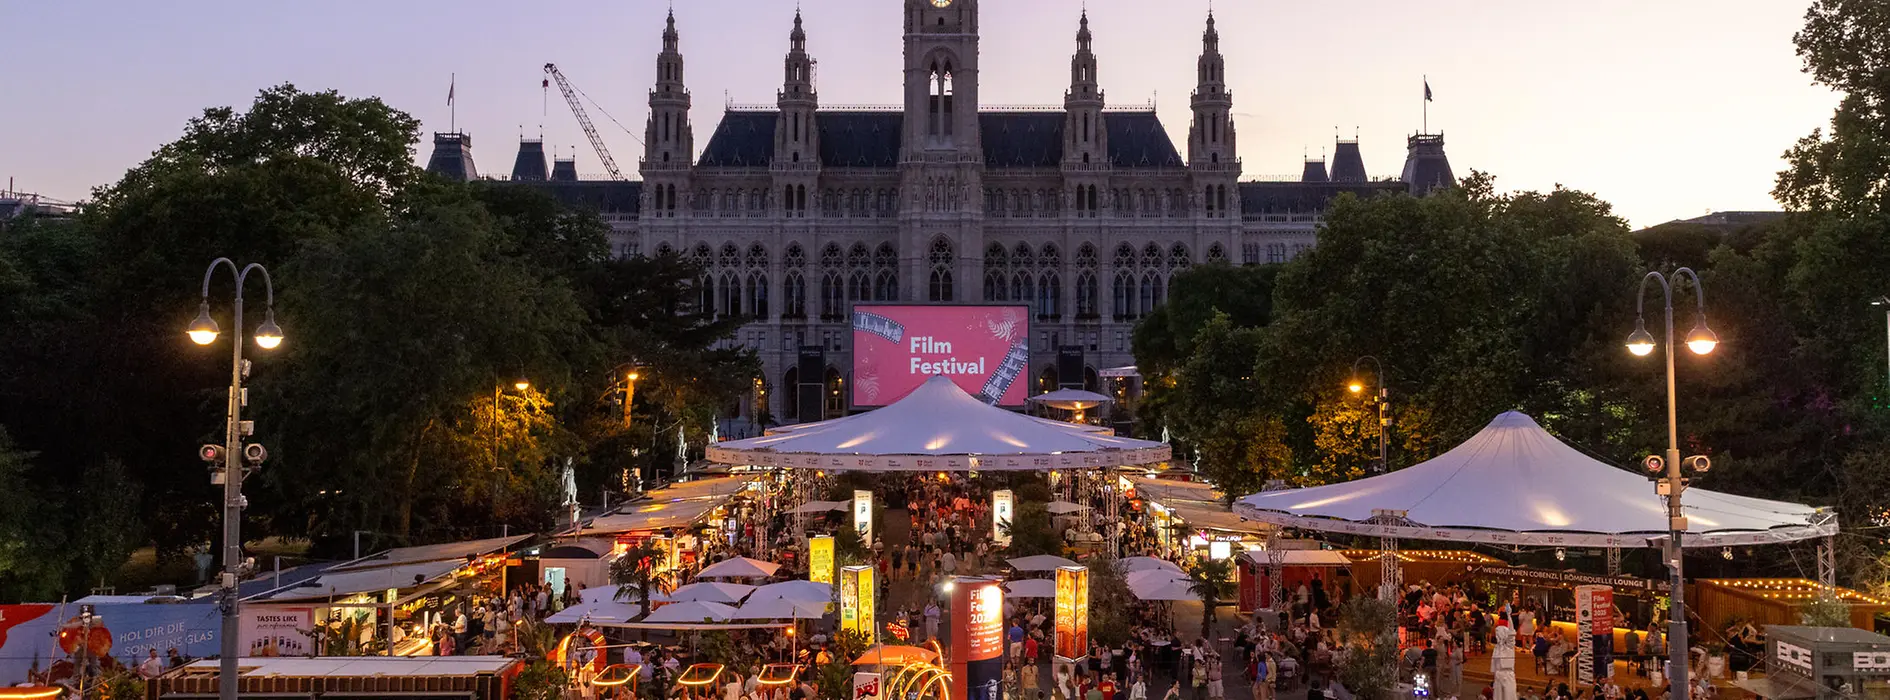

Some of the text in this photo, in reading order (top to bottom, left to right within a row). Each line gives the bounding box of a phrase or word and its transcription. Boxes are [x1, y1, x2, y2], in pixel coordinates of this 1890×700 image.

[910, 336, 952, 354] Film
[910, 356, 985, 375] Festival
[1482, 567, 1511, 576] WEINGUT
[1529, 571, 1559, 580] COBENZL
[1614, 579, 1644, 588] LOUNGE
[257, 615, 281, 623] TASTES
[120, 621, 185, 642] HOL DIR DIE
[124, 630, 214, 656] SONNE INS GLAS
[1777, 641, 1812, 670] BOE
[1853, 652, 1890, 668] BO
